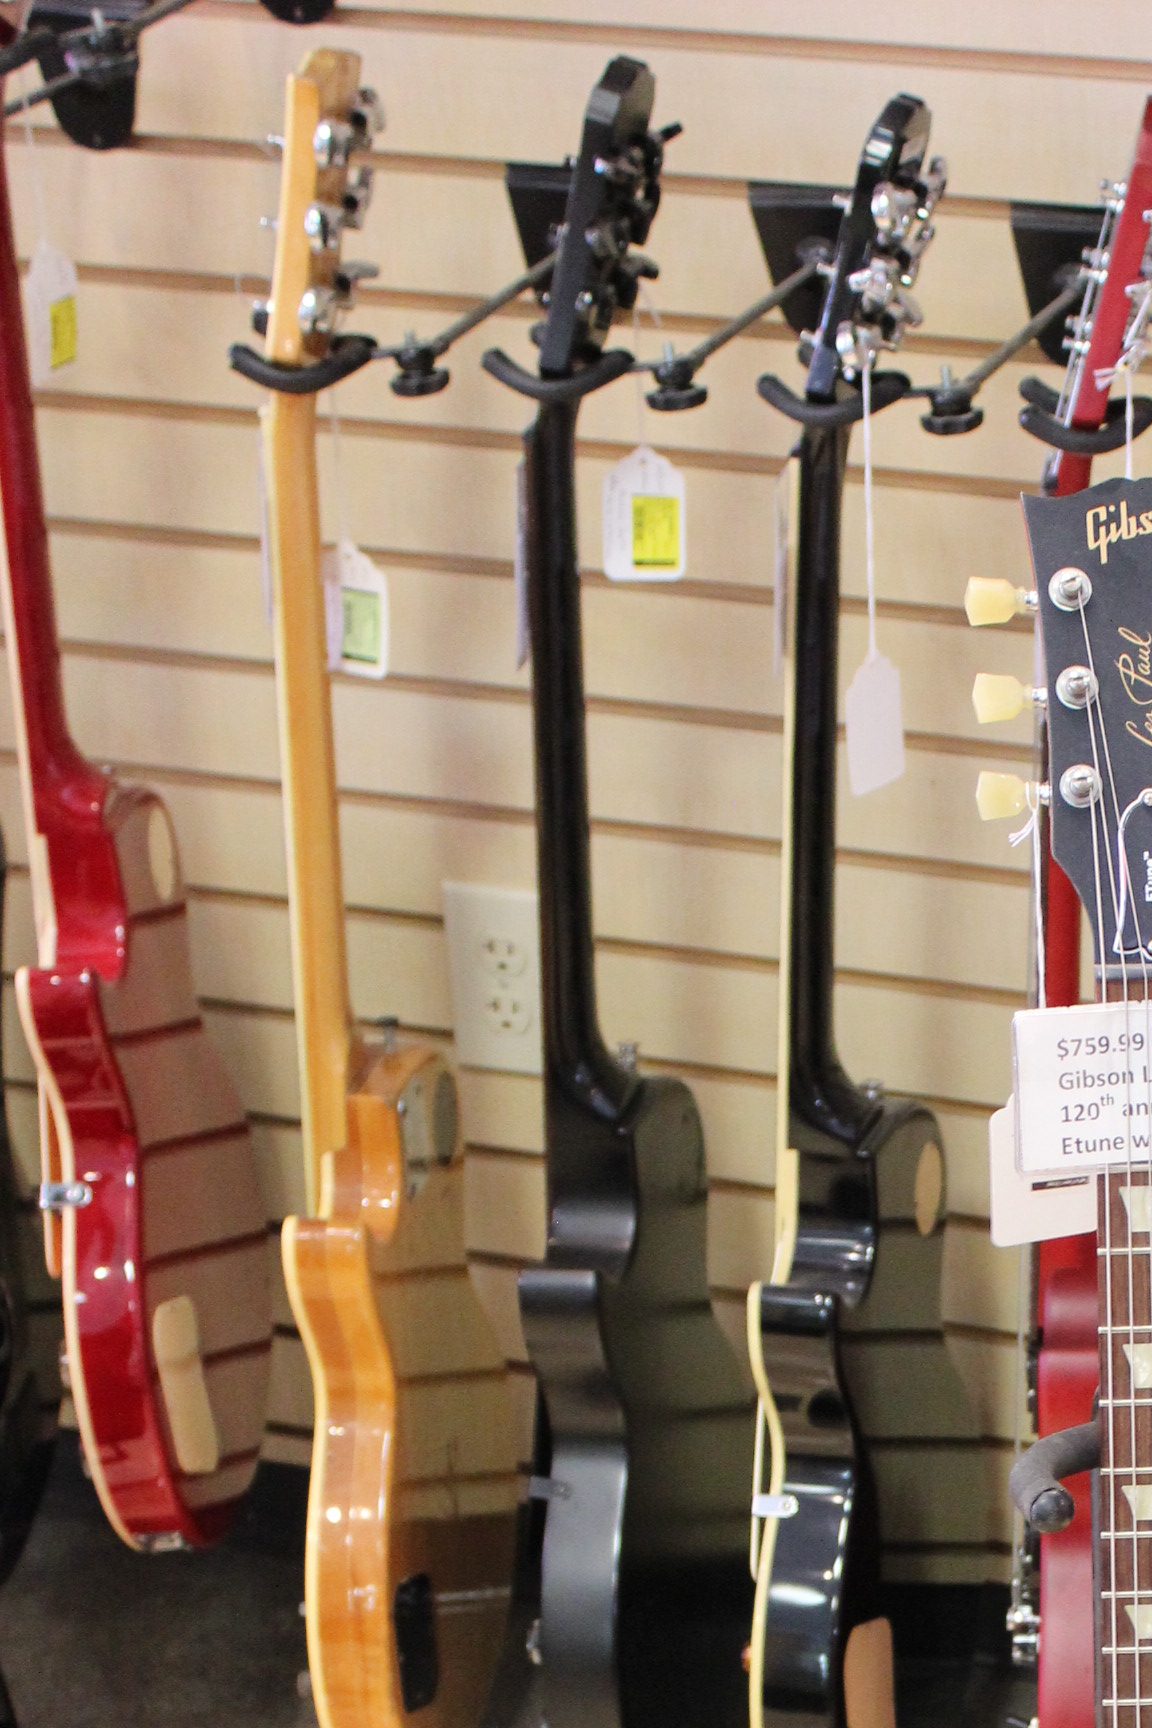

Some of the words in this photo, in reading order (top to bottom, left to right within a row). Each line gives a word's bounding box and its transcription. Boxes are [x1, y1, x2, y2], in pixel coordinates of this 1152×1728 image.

[1056, 1032, 1145, 1061] $759.99
[1058, 1068, 1134, 1091] Gibson
[1060, 1093, 1115, 1123] 120th
[1062, 1133, 1125, 1155] Etune
